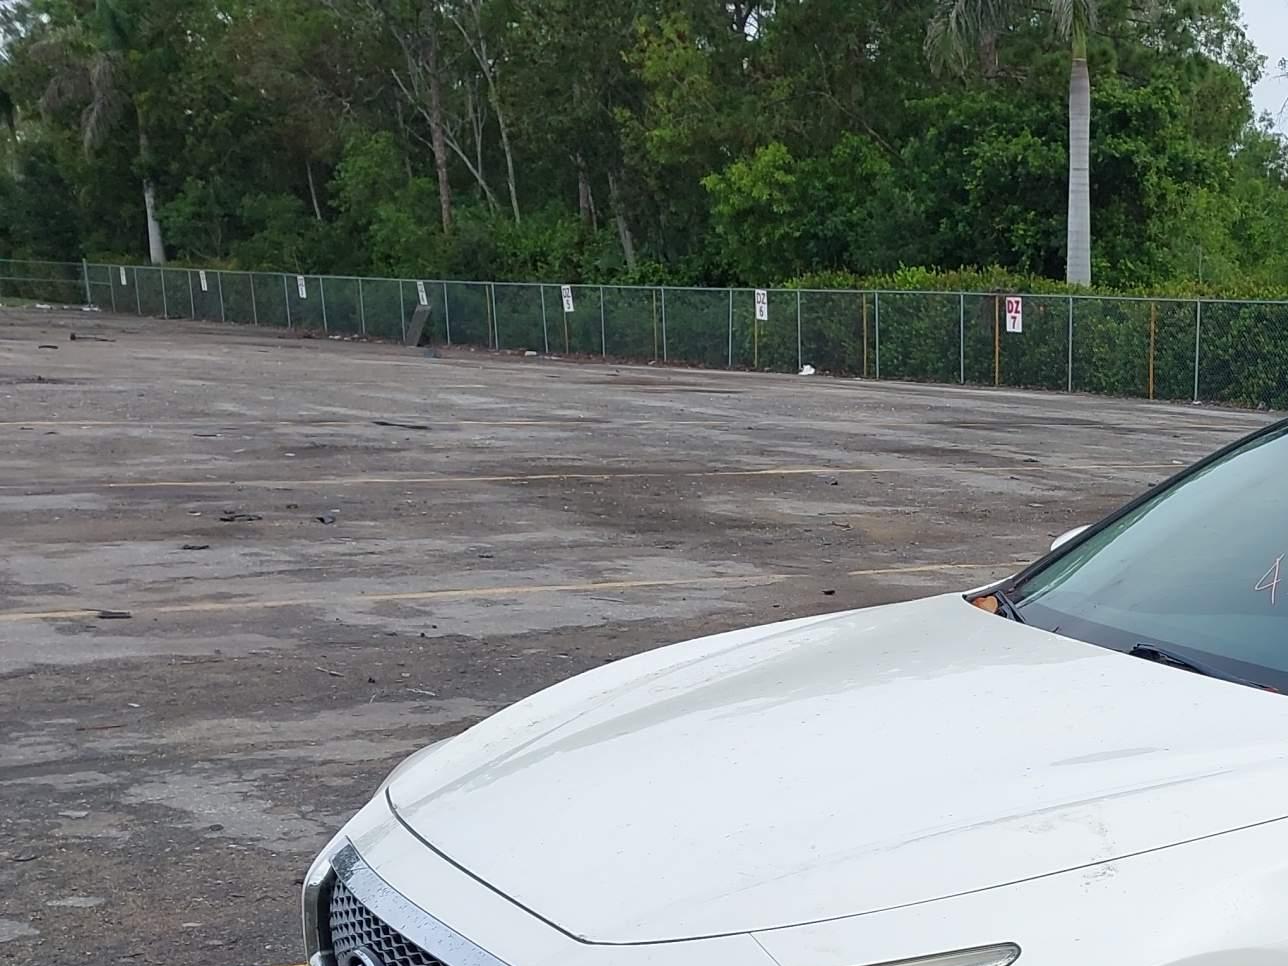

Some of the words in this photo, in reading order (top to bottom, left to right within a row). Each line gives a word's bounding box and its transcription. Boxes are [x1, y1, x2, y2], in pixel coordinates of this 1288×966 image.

[757, 292, 766, 305] DZ
[759, 305, 765, 317] 6
[1007, 300, 1021, 314] DZ
[1011, 316, 1017, 329] 7
